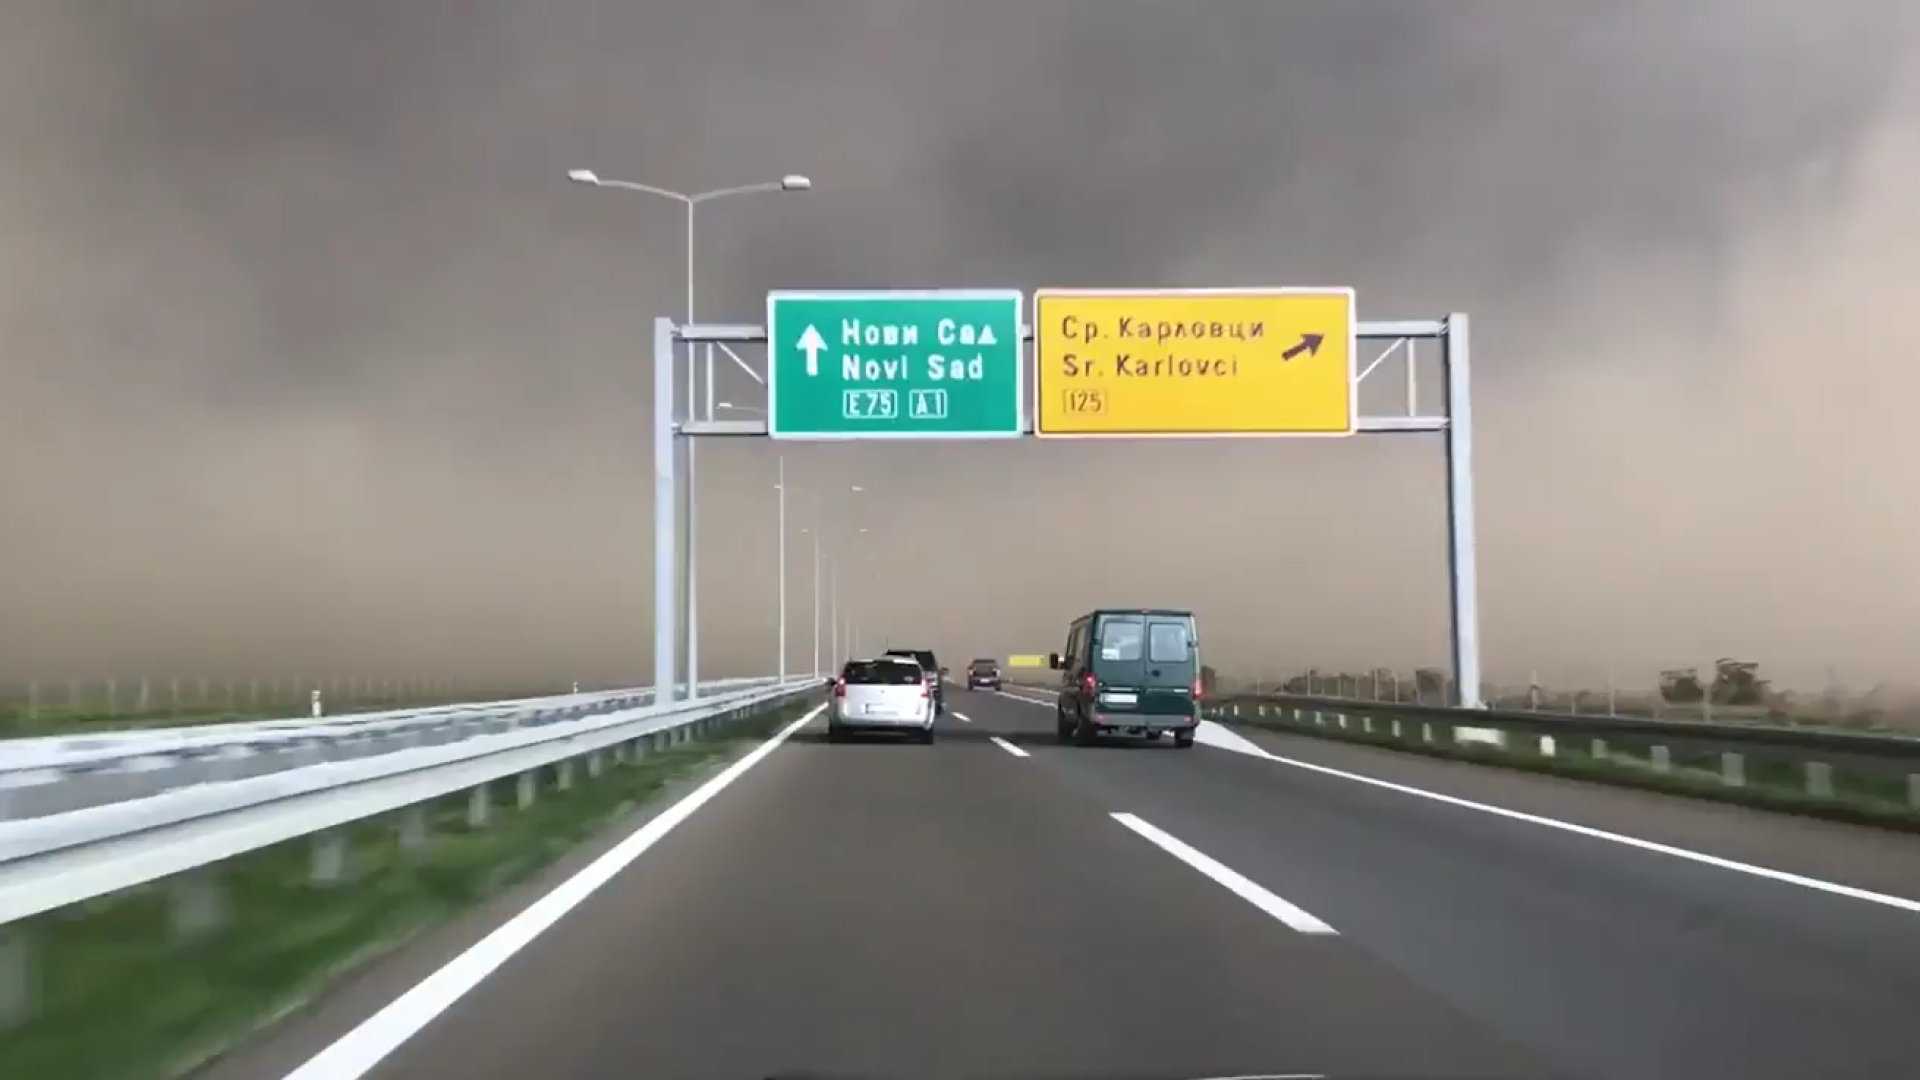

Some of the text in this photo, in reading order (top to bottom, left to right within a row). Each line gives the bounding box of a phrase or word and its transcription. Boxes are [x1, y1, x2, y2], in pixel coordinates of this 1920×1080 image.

[841, 318, 998, 345] Нови Сад
[1061, 316, 1264, 344] Ср. Карловци
[842, 353, 983, 381] Novi Sad
[1062, 354, 1238, 377] Sr. Karlovci
[1069, 392, 1102, 413] 125
